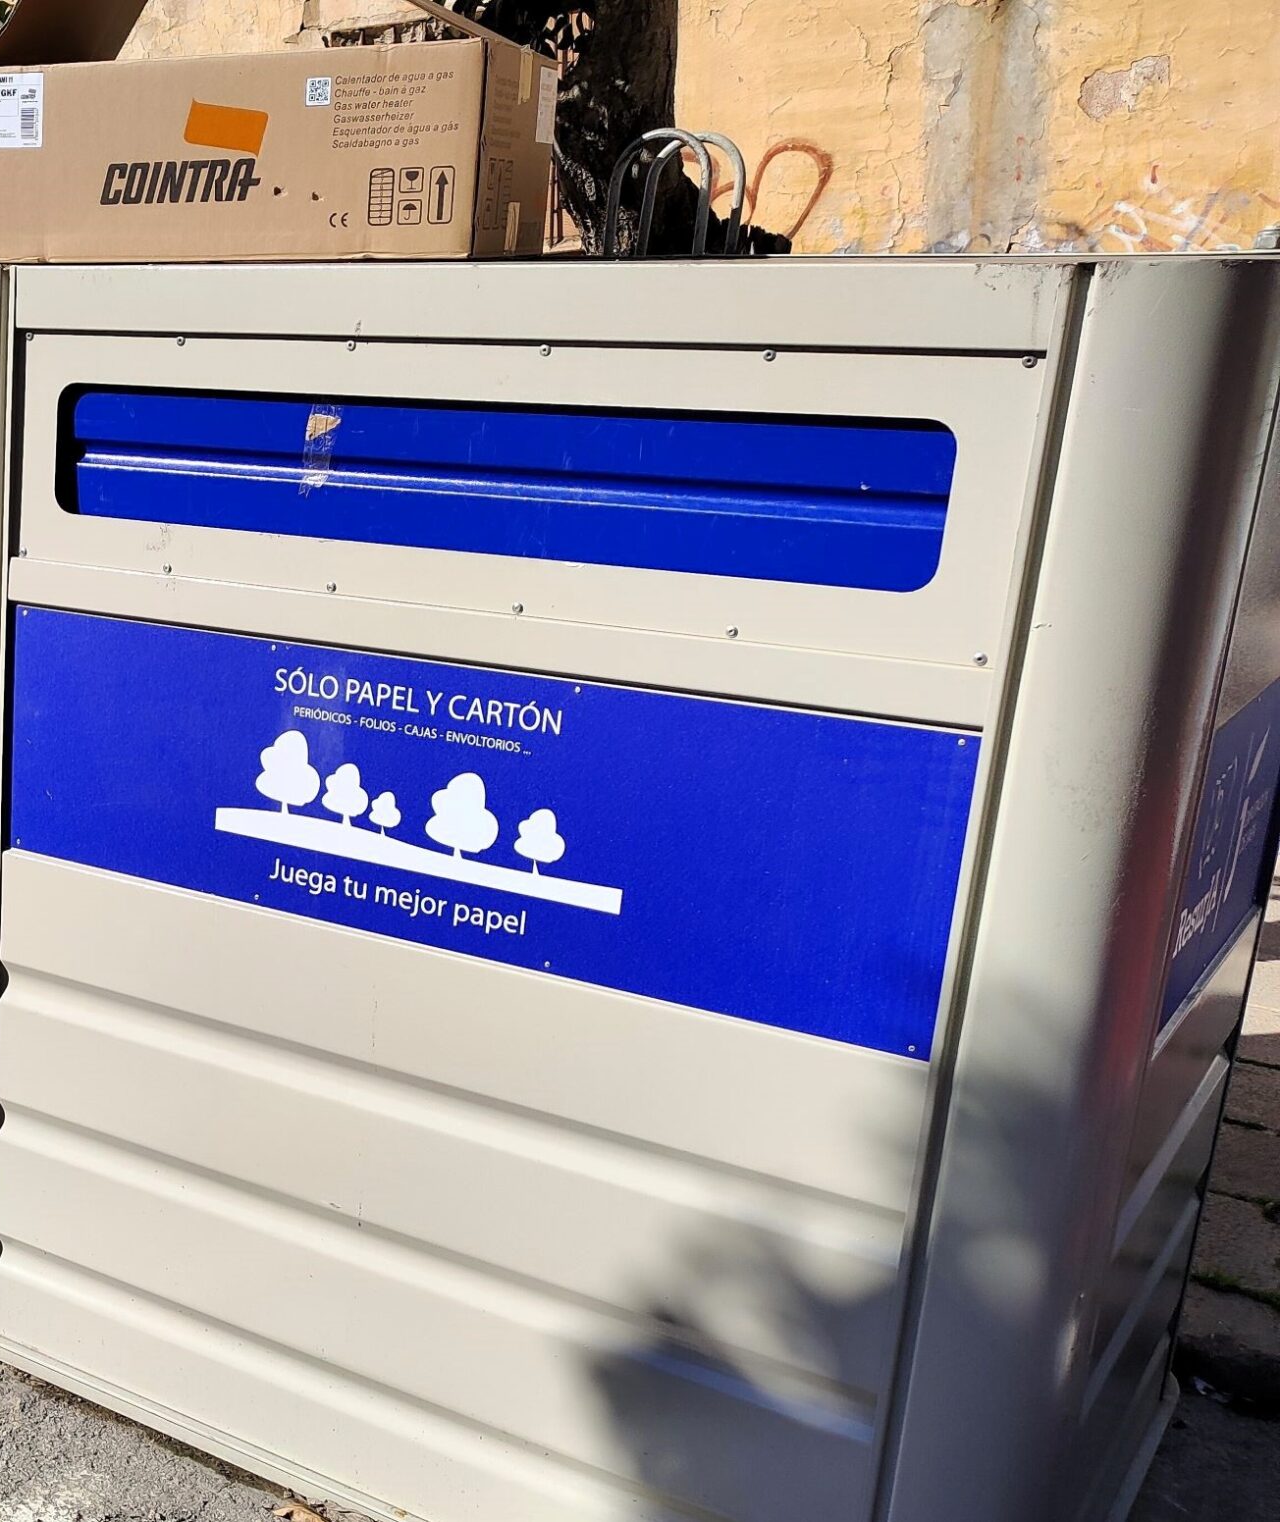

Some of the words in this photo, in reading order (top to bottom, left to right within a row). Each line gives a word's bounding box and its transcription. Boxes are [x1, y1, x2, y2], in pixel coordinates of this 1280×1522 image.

[335, 73, 387, 85] Calentador
[388, 72, 400, 81] de
[402, 74, 426, 83] agua
[436, 71, 454, 81] gas
[334, 86, 371, 98] Chauffe
[408, 85, 426, 96] gaz
[334, 102, 352, 111] Gas
[354, 100, 381, 110] water
[382, 99, 414, 109] heater
[333, 111, 415, 124] Gaswasserheizer
[332, 125, 392, 138] Esquentador
[393, 124, 405, 134] de
[407, 122, 431, 135] água
[433, 124, 439, 132] a
[440, 120, 459, 133] gás
[332, 138, 393, 149] Scaldabagno
[394, 138, 400, 146] a
[402, 137, 420, 148] gas
[99, 157, 261, 206] COINTRA
[275, 666, 339, 700] SÓLO
[345, 679, 420, 714] PAPEL
[426, 691, 444, 717] Y
[449, 695, 563, 736] CARTÓN
[294, 706, 352, 726] PERIÓDICOS
[359, 716, 396, 733] FOLIOS
[404, 723, 438, 740] CAJAS
[446, 730, 521, 754] ENVOLTORIOS
[269, 857, 337, 894] Juega
[343, 876, 367, 900] tu
[375, 888, 448, 918] mejor
[453, 902, 527, 936] papel
